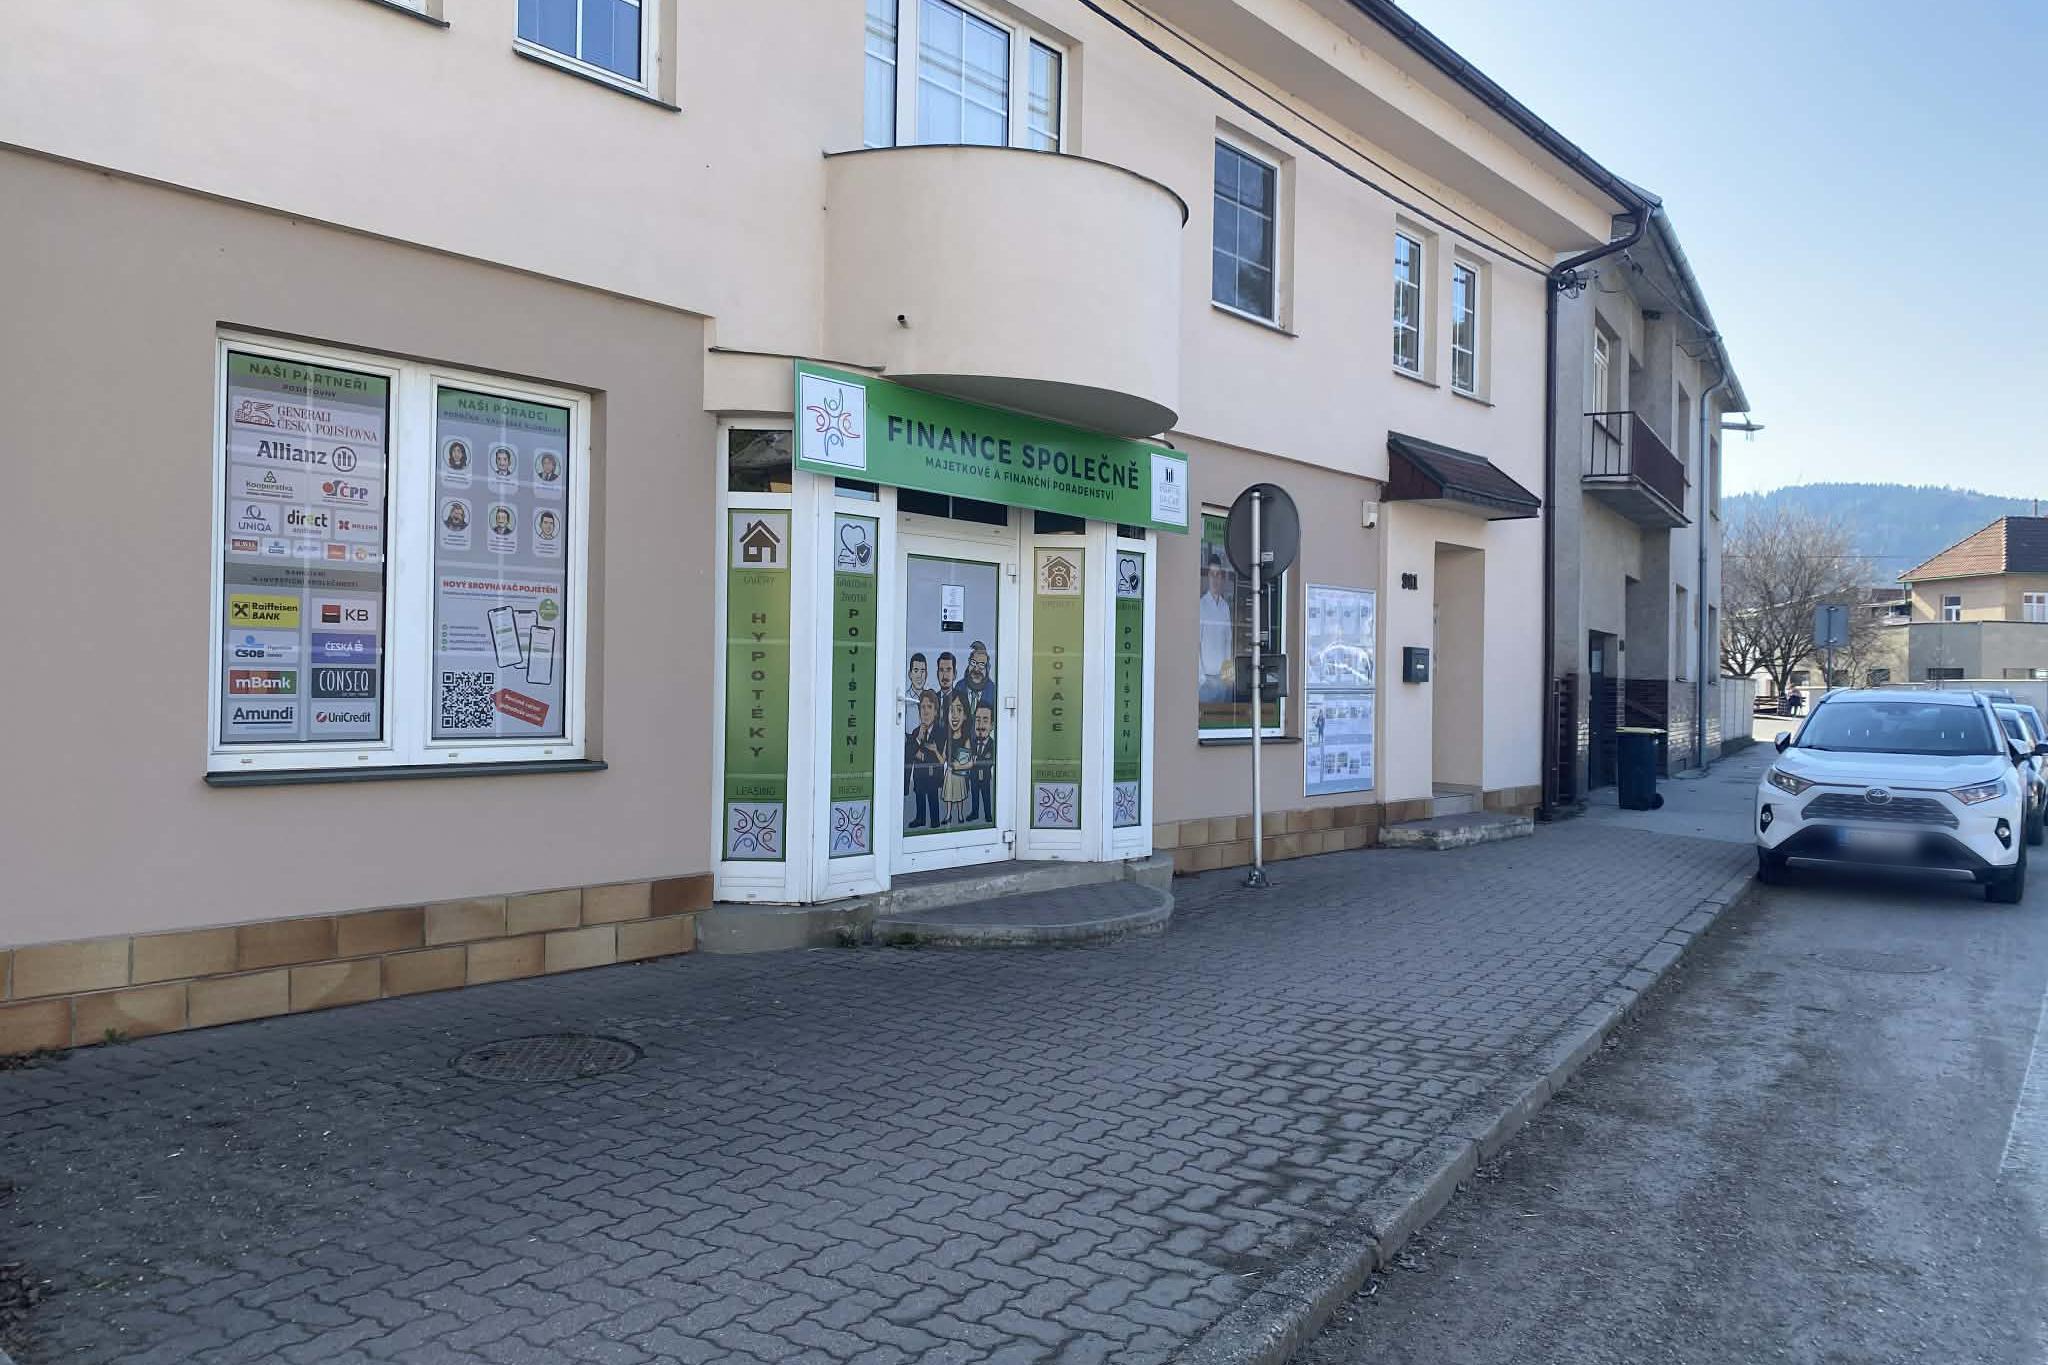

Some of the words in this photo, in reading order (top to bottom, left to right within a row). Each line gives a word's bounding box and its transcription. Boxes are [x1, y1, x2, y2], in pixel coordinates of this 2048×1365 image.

[250, 363, 286, 378] NAŠI
[293, 370, 368, 391] PARTNEŘI
[277, 406, 331, 422] GENERALI
[256, 440, 328, 465] Allianz
[888, 415, 1012, 464] FINANCE
[1022, 444, 1139, 490] SPOLEČNĚ
[926, 456, 991, 478] MAJETKOVÉ
[994, 470, 1001, 480] A
[1004, 472, 1050, 490] FINANČNÍ
[1053, 480, 1114, 501] PORADENSTVÍ
[340, 482, 368, 499] ČPP
[238, 521, 272, 532] UNIQA
[287, 510, 328, 528] direct
[252, 602, 298, 612] Raiffeisen
[345, 608, 369, 622] KB
[252, 612, 280, 621] BANK
[236, 648, 265, 658] ČSOB
[236, 676, 291, 689] mBank
[319, 670, 369, 691] CONSEQ
[1051, 646, 1064, 732] DOTACE
[232, 706, 293, 720] Amundi
[328, 712, 371, 723] UniCredit
